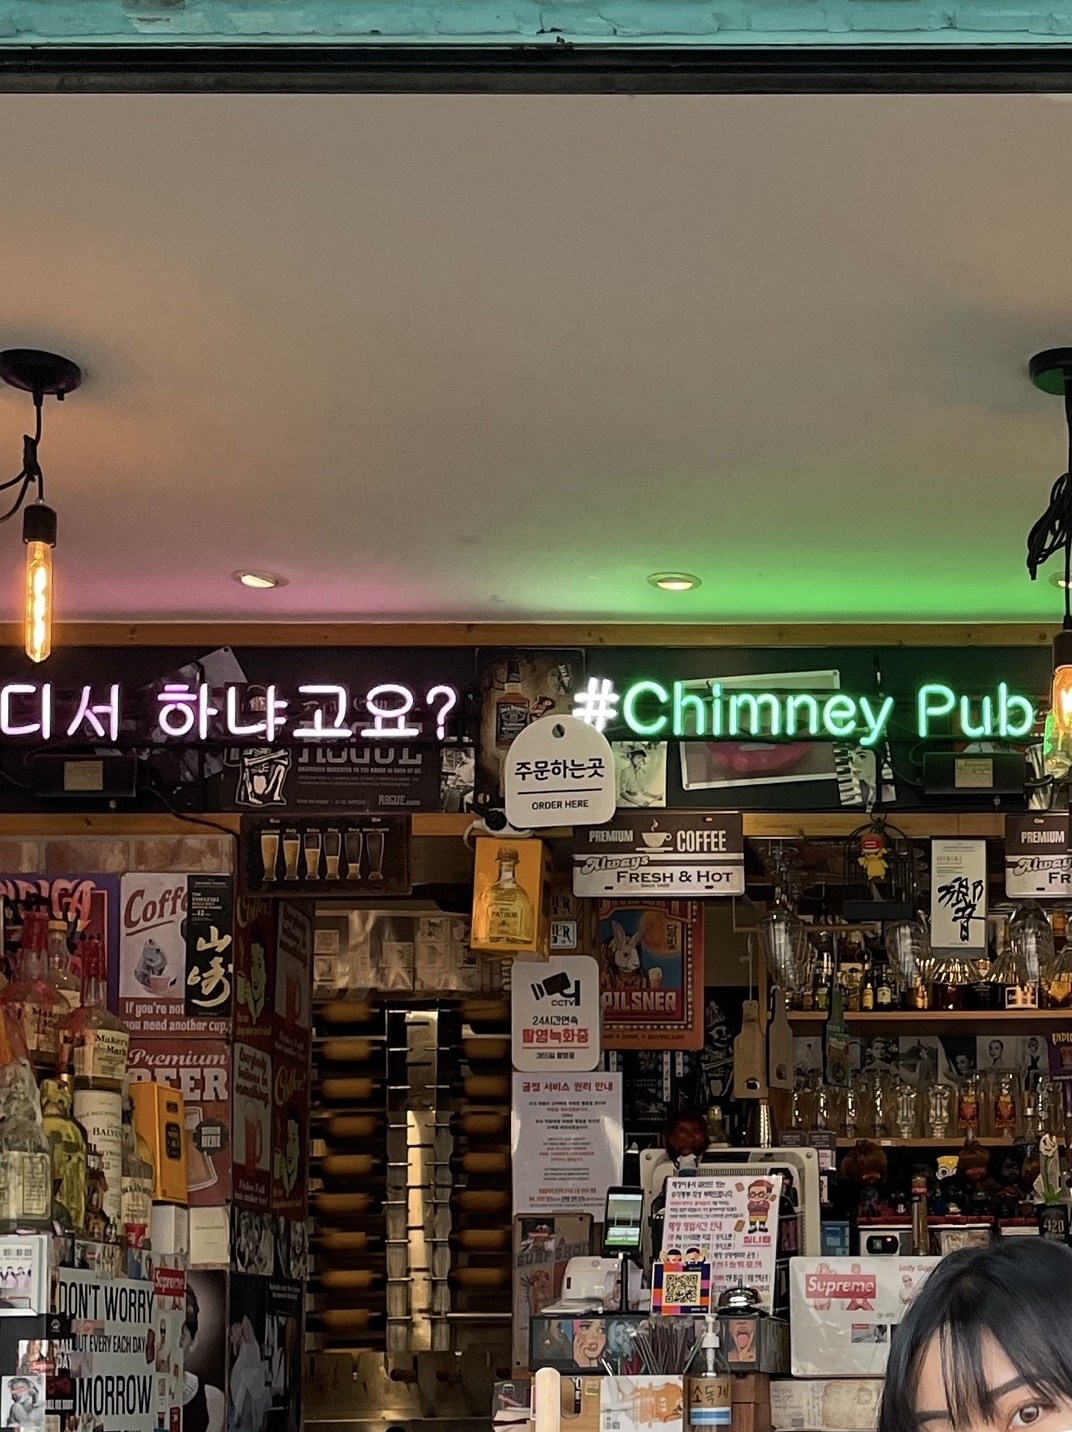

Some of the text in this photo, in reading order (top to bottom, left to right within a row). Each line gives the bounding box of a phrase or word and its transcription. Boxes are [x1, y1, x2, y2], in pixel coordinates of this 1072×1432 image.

[157, 682, 457, 742] 하냐고요?
[514, 757, 605, 781] 주문하는곳
[531, 799, 589, 810] ORDER HERE
[589, 830, 727, 852] PREMIUM COFFEE
[1021, 831, 1065, 843] PREMIUM
[580, 855, 650, 875] Always
[678, 871, 692, 882] &
[125, 1001, 134, 1014] If
[135, 1001, 167, 1018] you're
[601, 991, 677, 1012] PILSNER
[143, 1019, 167, 1031] need
[169, 1019, 207, 1031] another
[126, 1048, 228, 1066] Premium
[543, 1081, 614, 1093] 서비스 권리 안내
[155, 1270, 184, 1293] Supreme
[807, 1276, 875, 1297] Supreme
[59, 1281, 155, 1324] DON'T WORRY
[90, 1335, 146, 1353] EVERY EACH DAY
[691, 1385, 729, 1404] 소독제
